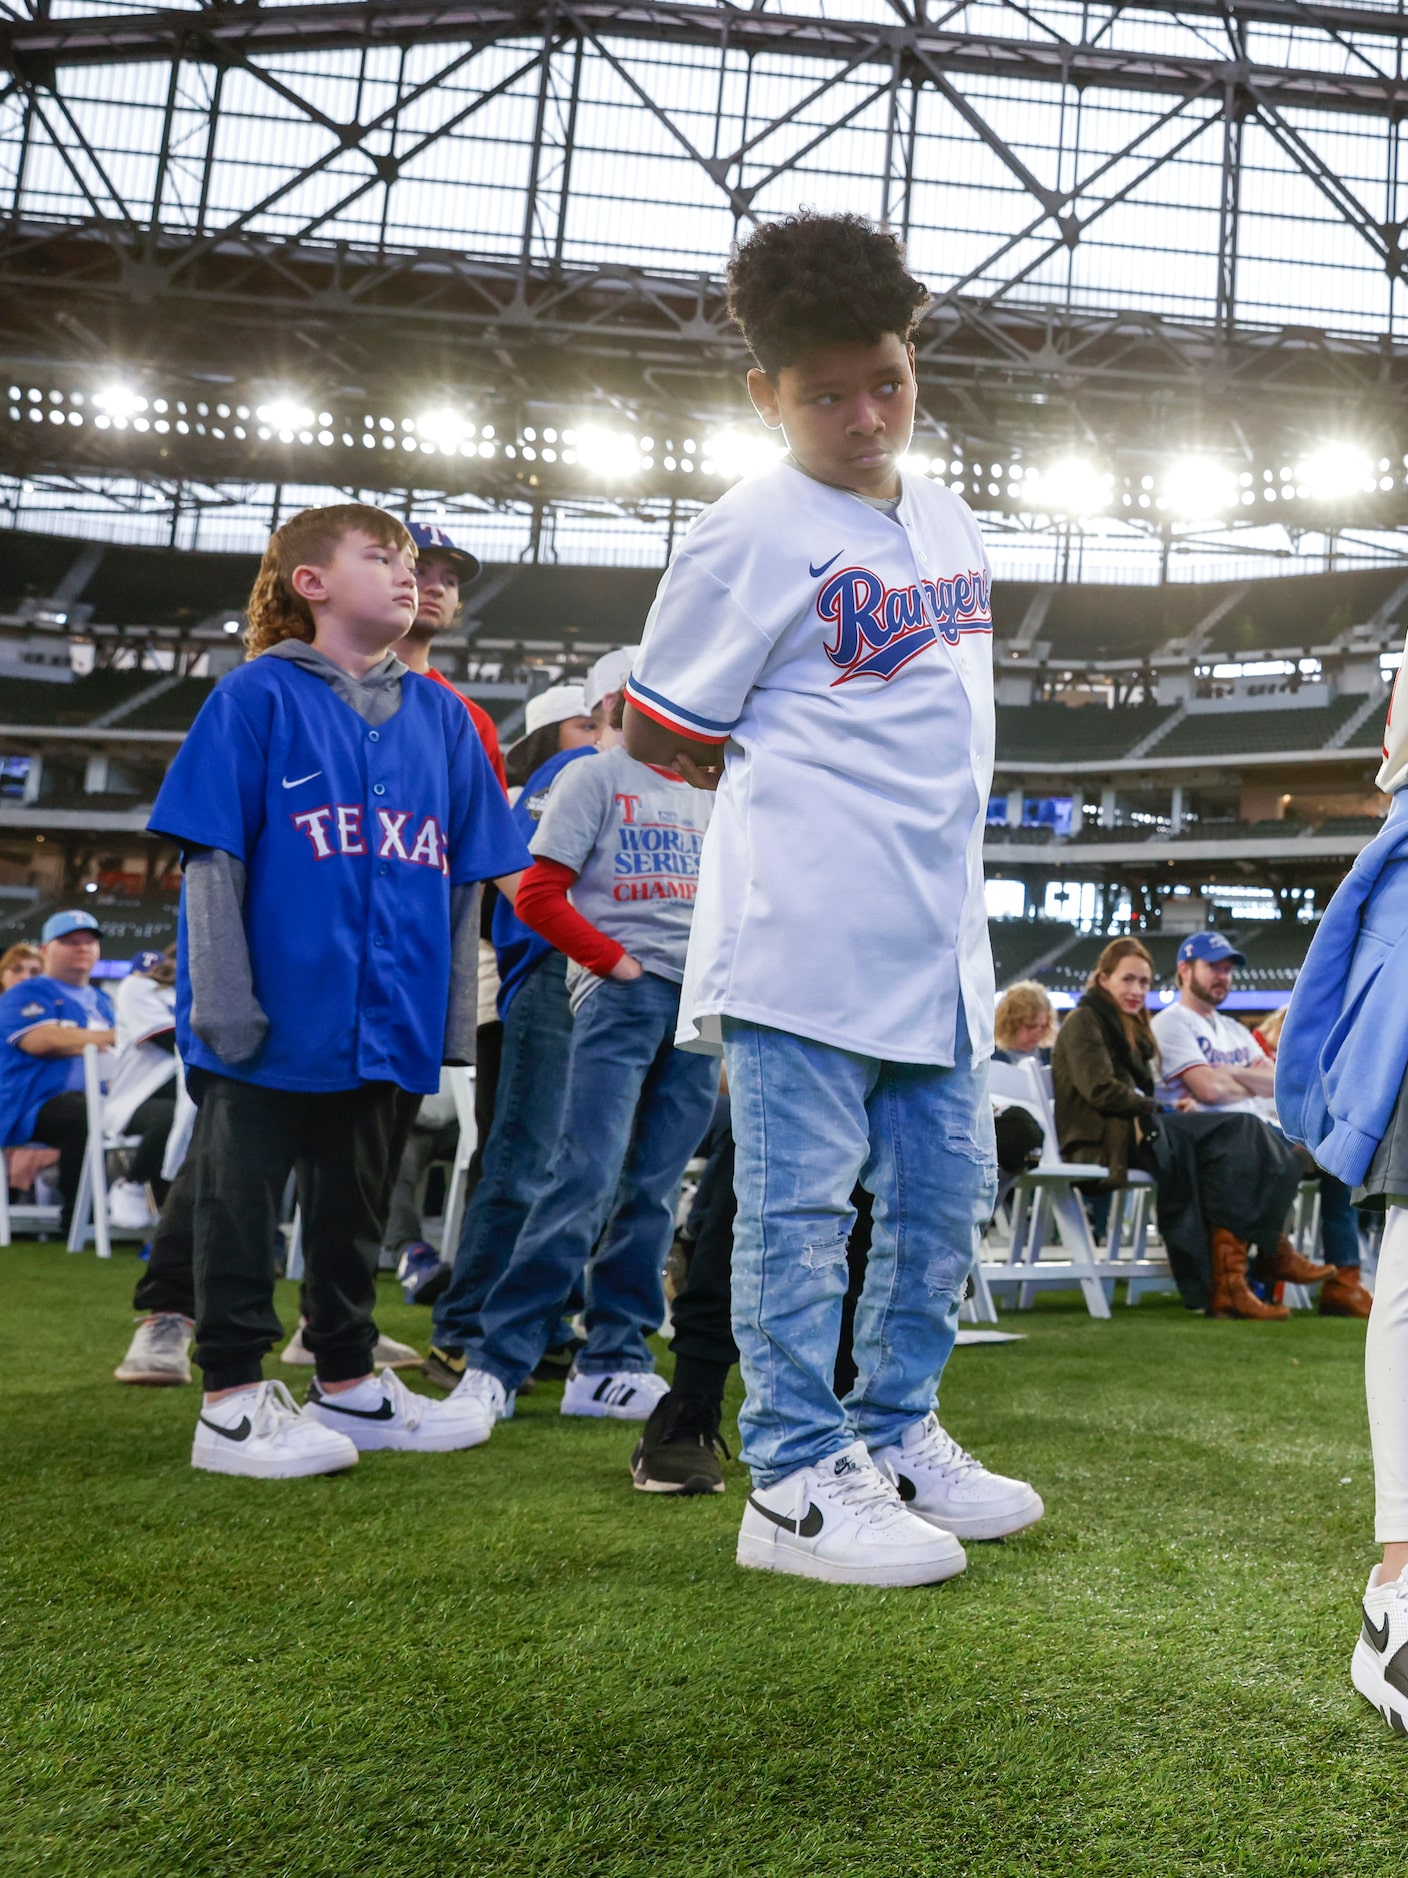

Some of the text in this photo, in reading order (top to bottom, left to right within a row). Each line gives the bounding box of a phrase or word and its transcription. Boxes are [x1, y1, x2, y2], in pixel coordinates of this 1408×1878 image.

[419, 523, 446, 547] T
[816, 566, 993, 669] Ranger
[614, 793, 642, 825] T
[290, 803, 449, 878] TEXA
[618, 829, 704, 854] WORLD
[613, 881, 697, 902] CHAMP
